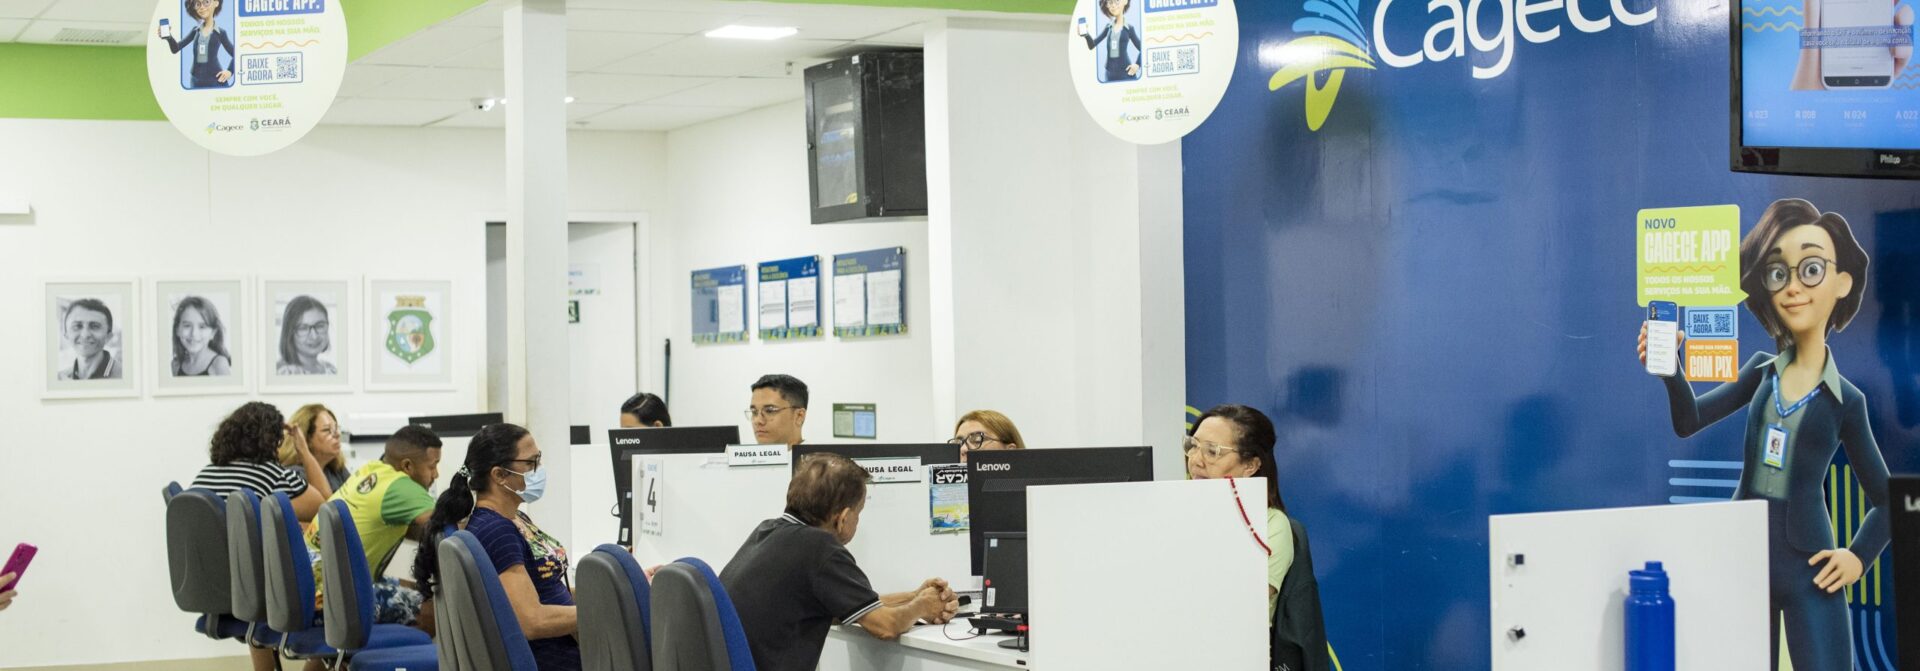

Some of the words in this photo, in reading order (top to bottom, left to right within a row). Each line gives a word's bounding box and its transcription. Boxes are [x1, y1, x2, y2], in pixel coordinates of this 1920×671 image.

[1152, 50, 1170, 62] BAIXE
[248, 57, 269, 69] BAIXE
[1152, 62, 1174, 73] AGORA
[248, 69, 273, 81] AGORA
[1164, 106, 1190, 115] CEARÁ
[261, 116, 291, 126] CEARÁ
[216, 124, 244, 132] Cagece
[1645, 218, 1676, 230] NOVO
[1645, 231, 1699, 263] CAGECE
[1701, 230, 1731, 262] APP
[1693, 313, 1710, 324] BAIXE
[1693, 323, 1713, 334] AGORA
[1690, 355, 1713, 378] COM
[1715, 355, 1733, 378] PIX
[615, 436, 641, 445] Lenovo
[976, 462, 1011, 472] Lenovo
[647, 477, 657, 513] 4
